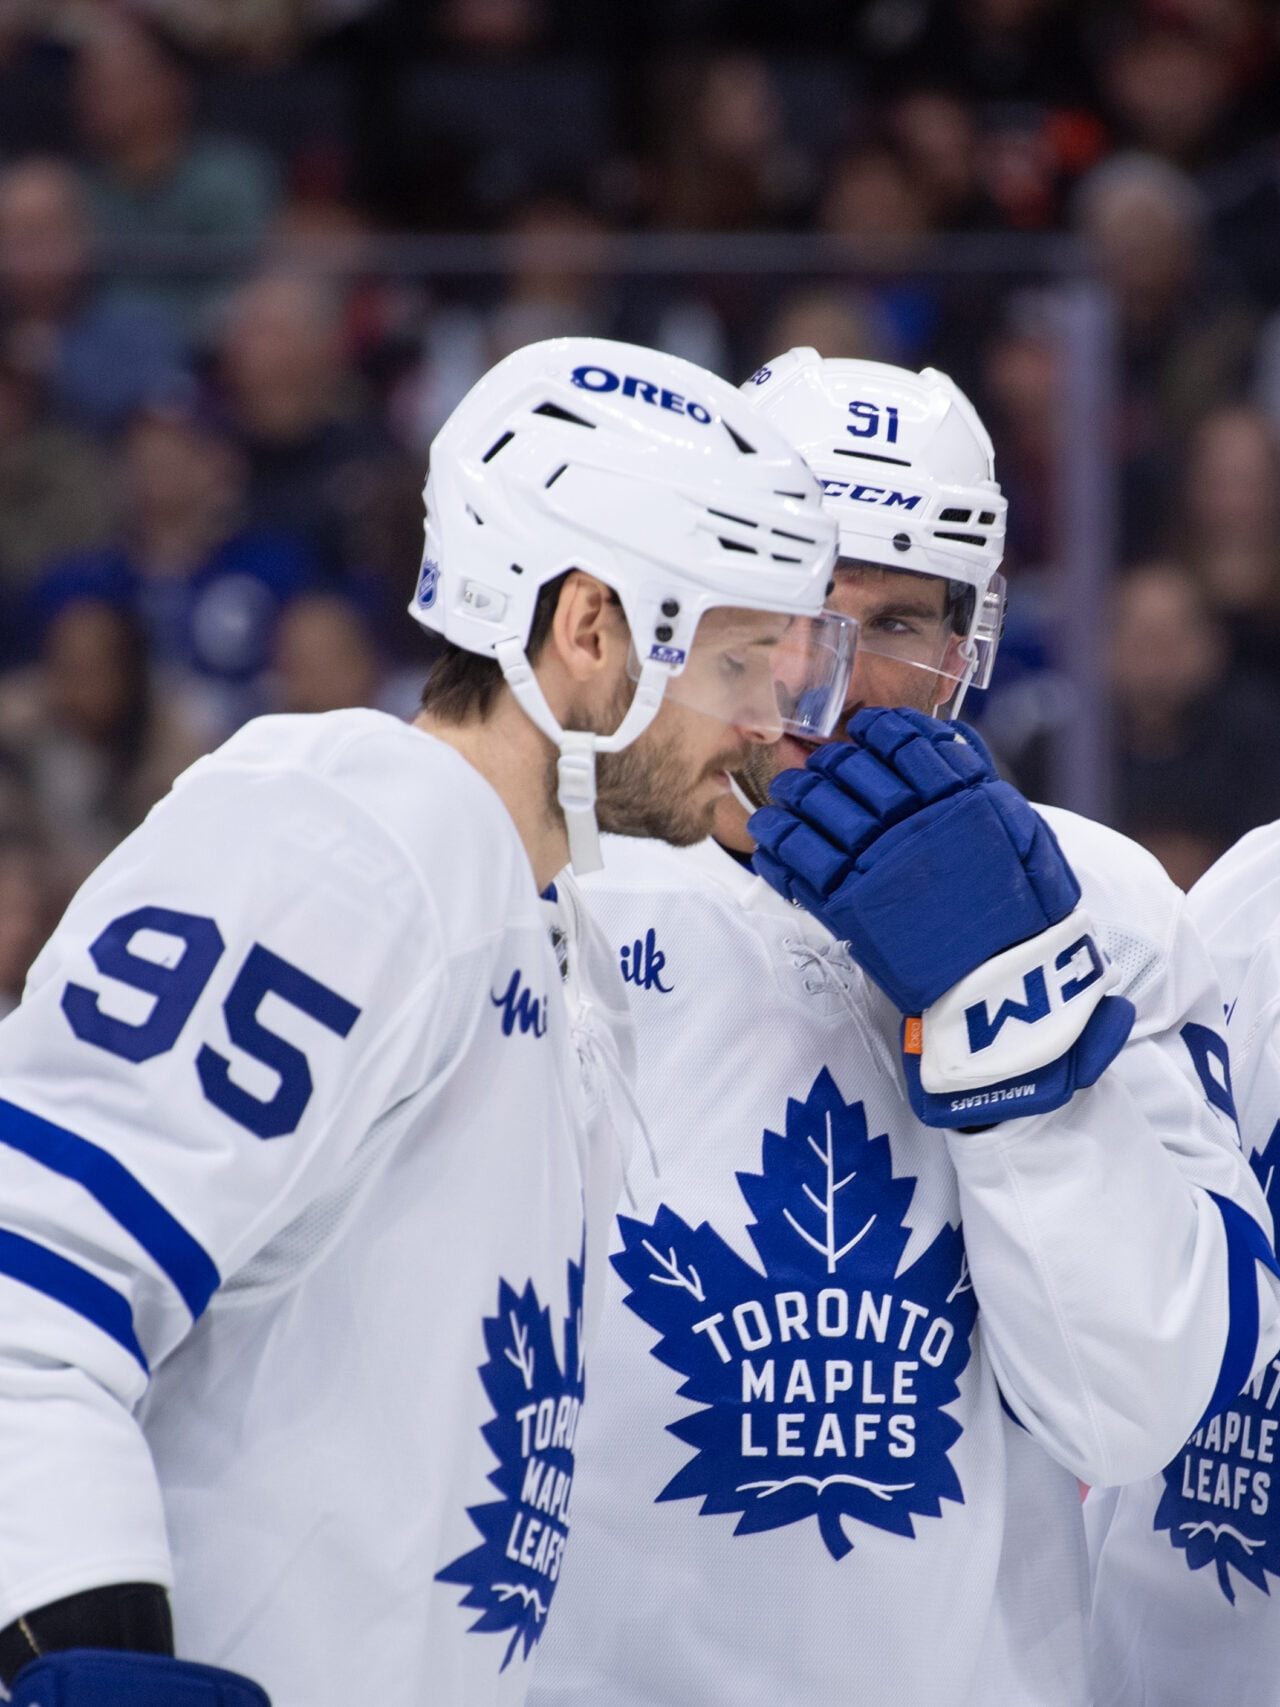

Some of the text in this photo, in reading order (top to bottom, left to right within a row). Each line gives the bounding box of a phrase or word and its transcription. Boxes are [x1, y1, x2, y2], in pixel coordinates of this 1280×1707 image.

[570, 365, 712, 424] OREO
[847, 400, 899, 444] 91
[820, 479, 923, 511] CCM
[620, 927, 675, 993] ilk
[60, 905, 362, 1140] 95
[964, 933, 1111, 1054] CM
[692, 1287, 955, 1367] TORONTO
[741, 1358, 919, 1405] MAPLE
[516, 1395, 580, 1459] TORO
[741, 1413, 917, 1458] LEAFS
[520, 1456, 571, 1528] MAPL
[1181, 1454, 1271, 1516] LEAFS
[505, 1511, 567, 1582] LEAFS
